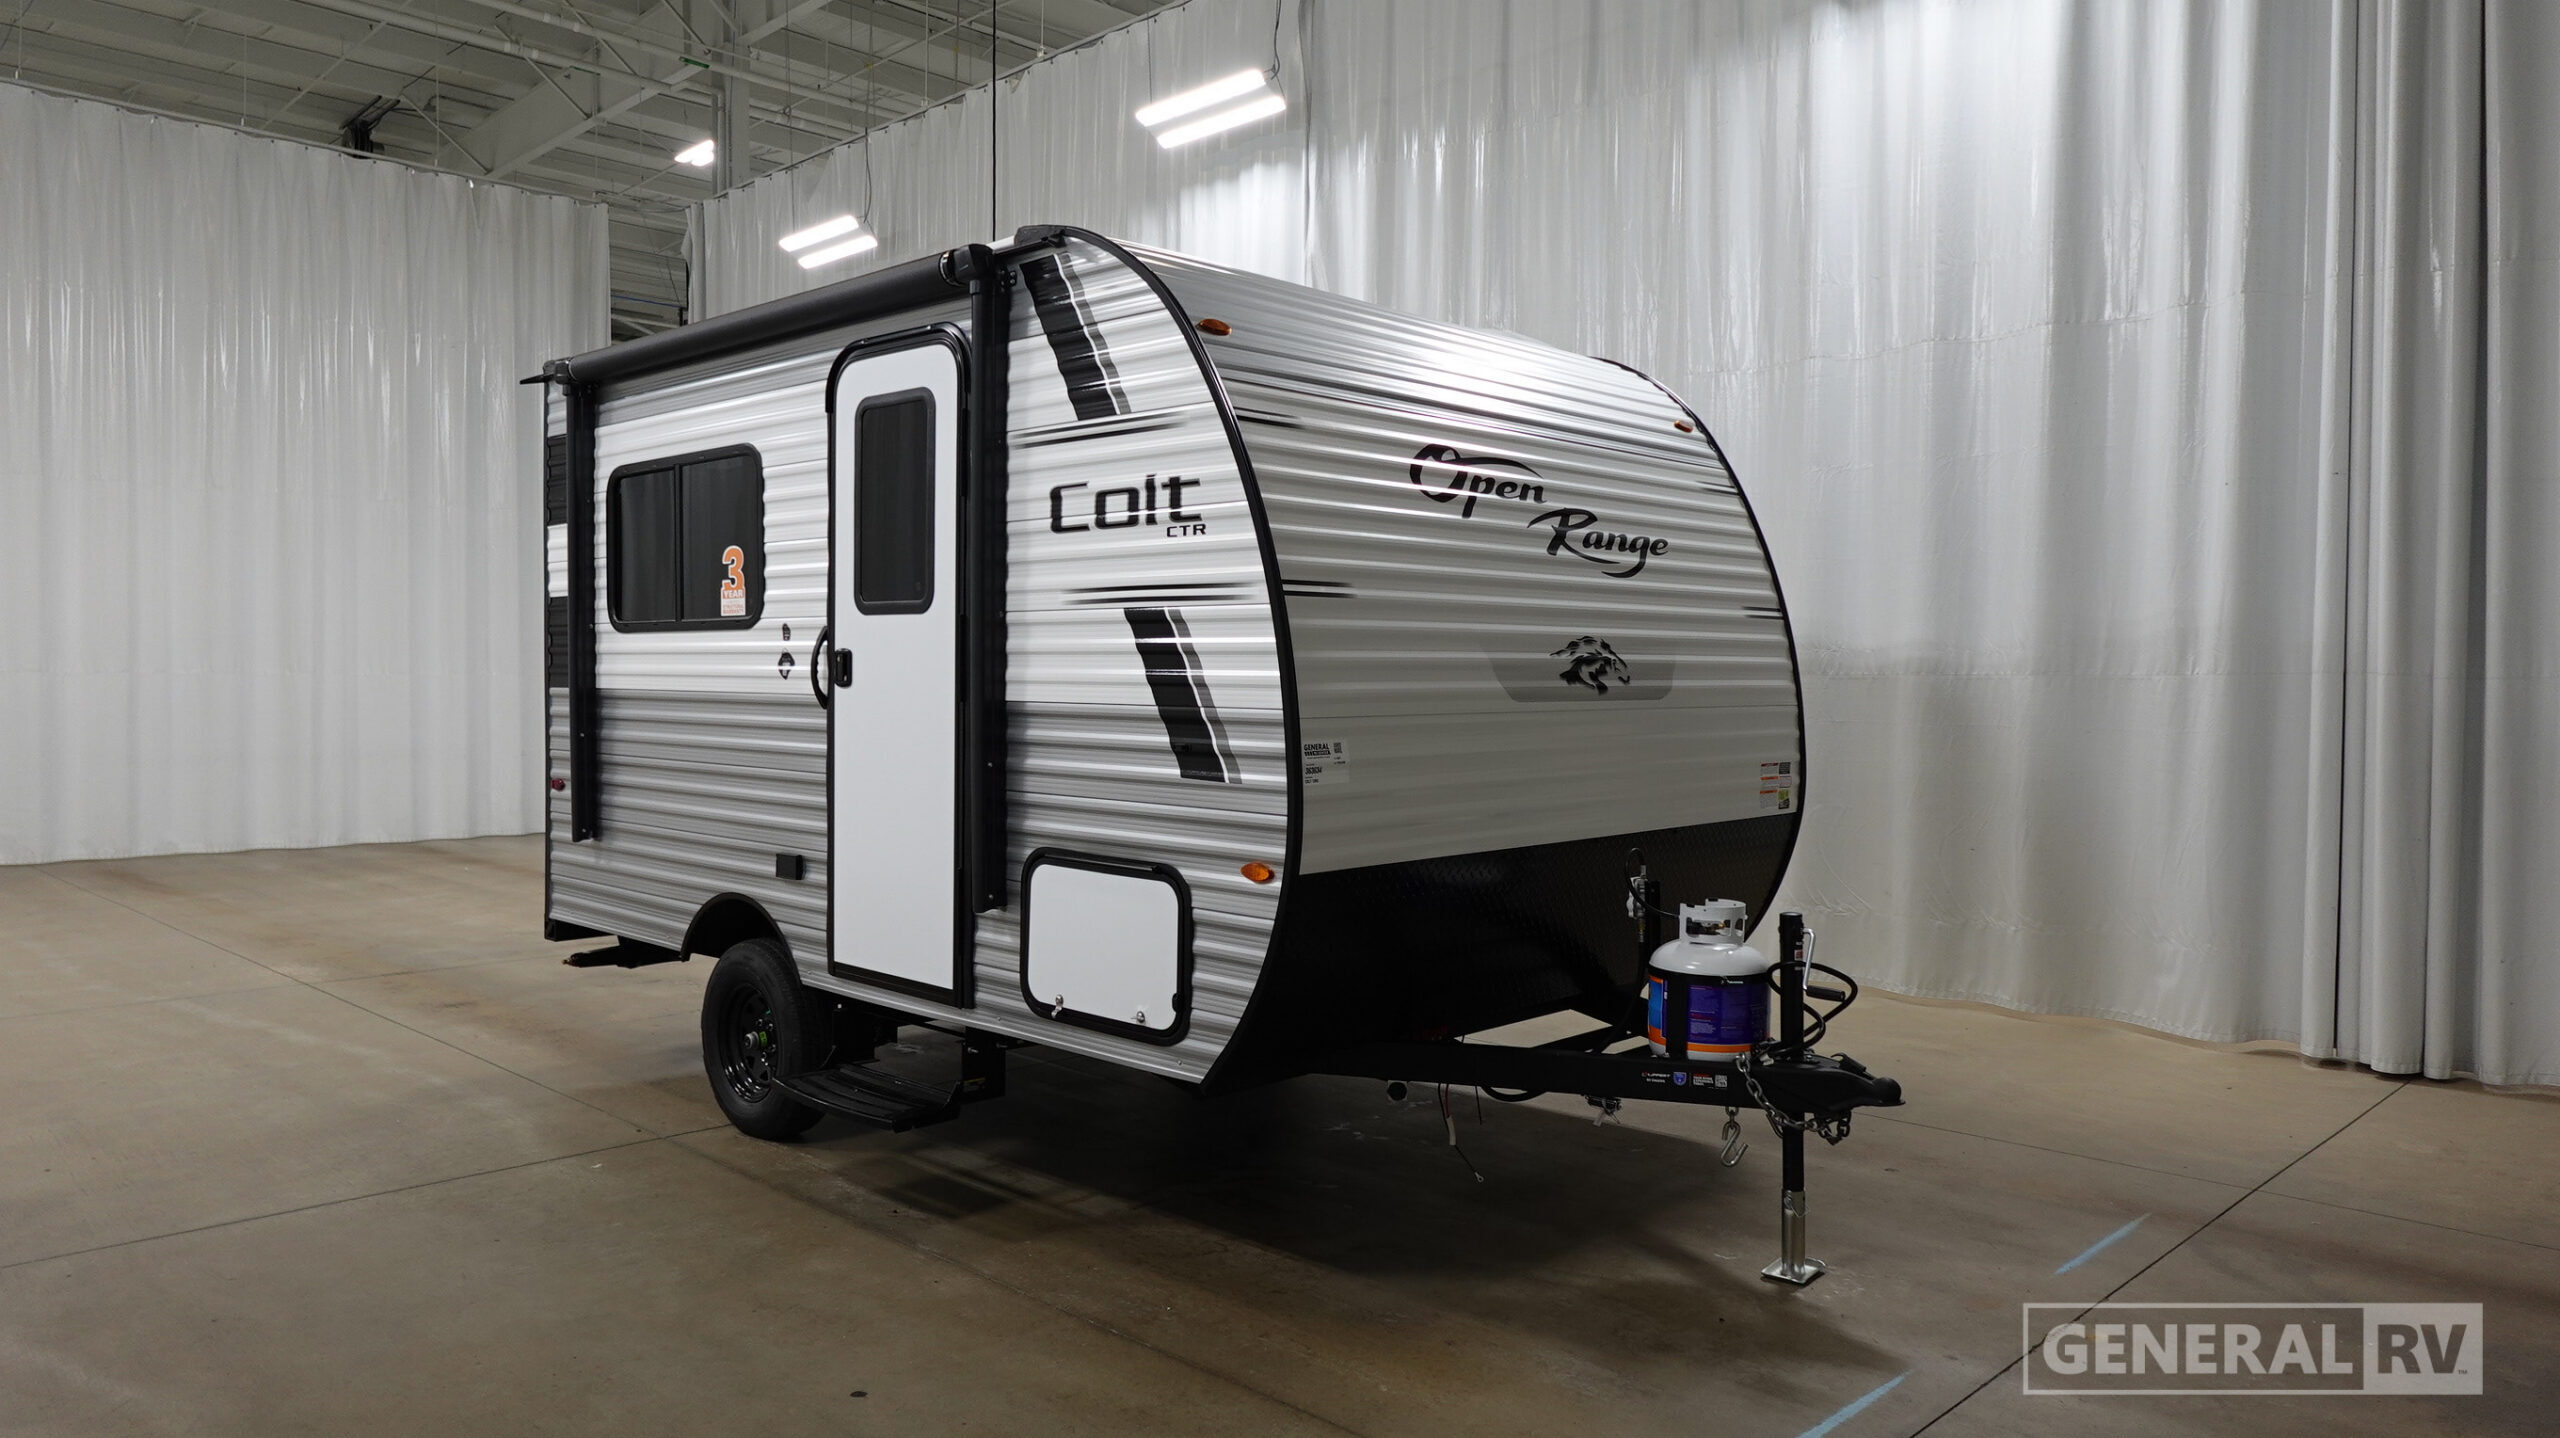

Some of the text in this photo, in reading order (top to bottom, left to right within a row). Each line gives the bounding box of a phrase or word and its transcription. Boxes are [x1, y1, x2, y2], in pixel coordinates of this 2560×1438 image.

[1050, 473, 1203, 533] Colt
[1410, 444, 1547, 519] Open
[1167, 523, 1207, 537] CTR
[1526, 508, 1669, 578] Range
[722, 546, 745, 591] 3
[723, 590, 744, 598] YEAR
[1304, 743, 1330, 751] GENERAL
